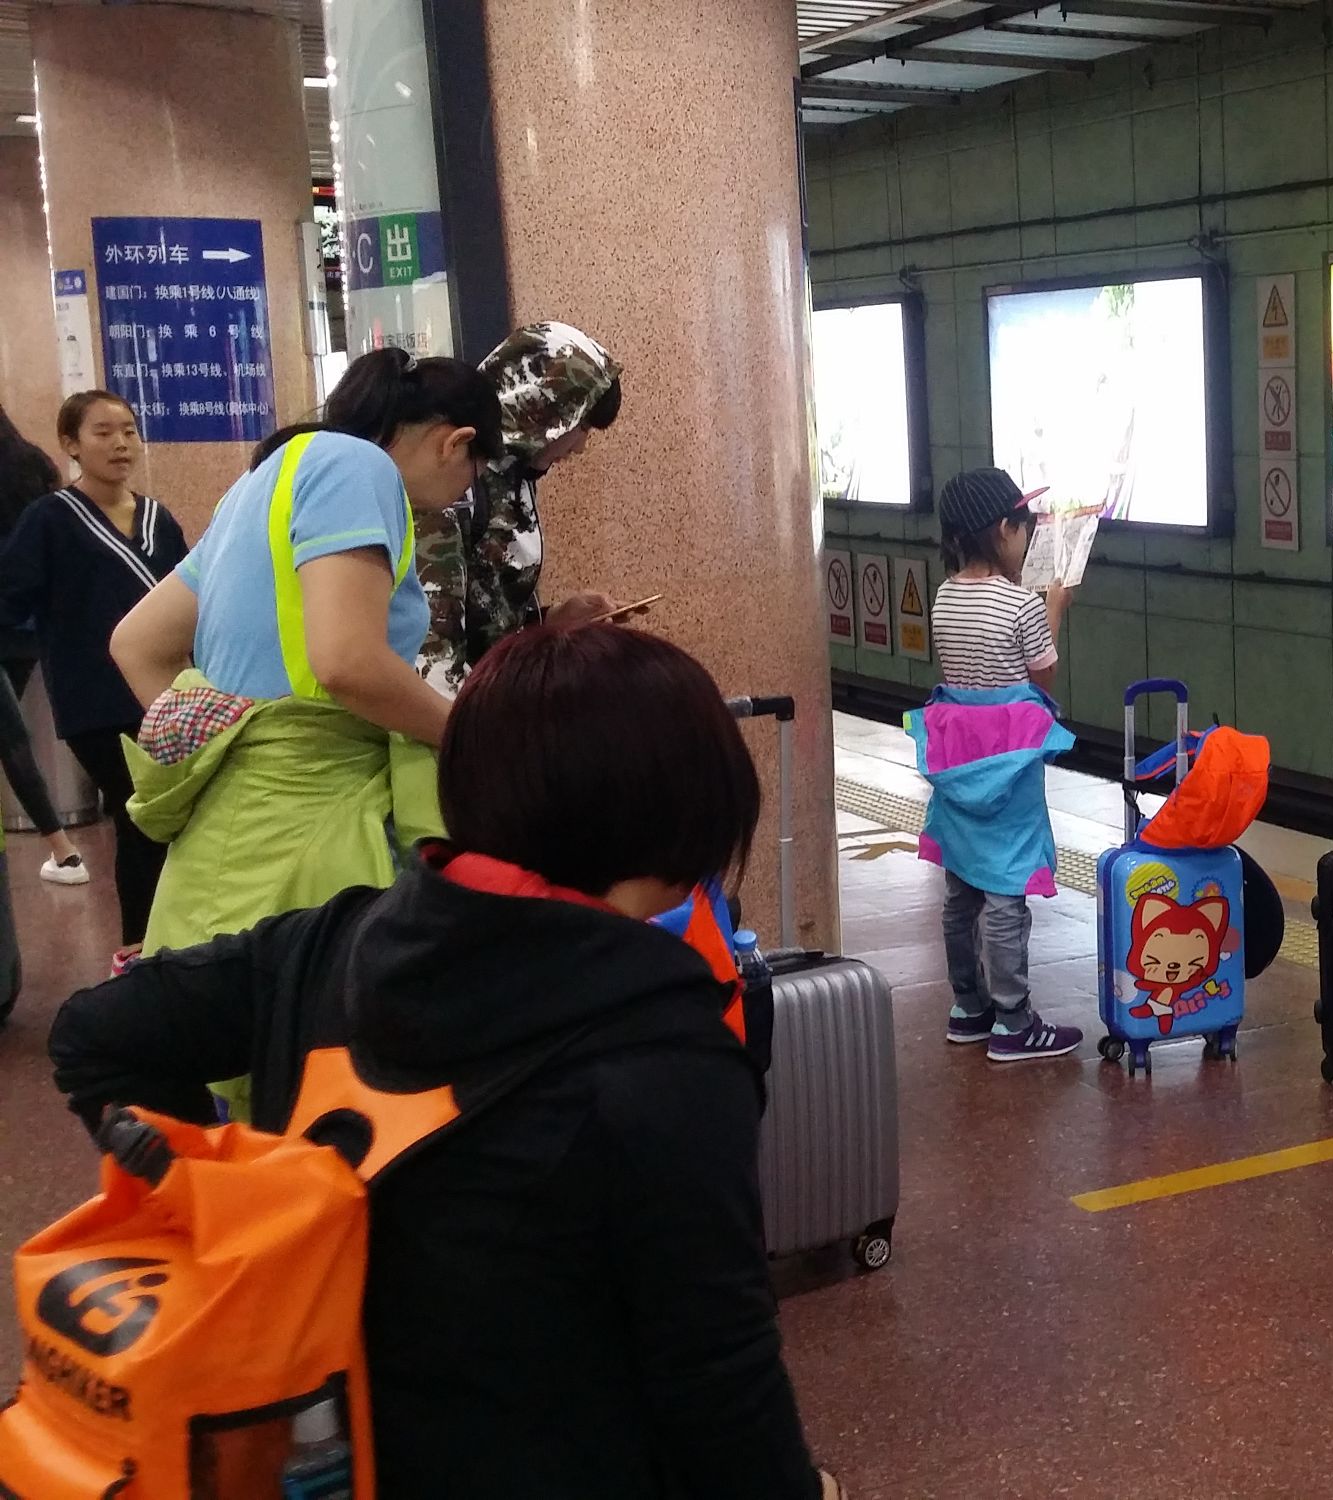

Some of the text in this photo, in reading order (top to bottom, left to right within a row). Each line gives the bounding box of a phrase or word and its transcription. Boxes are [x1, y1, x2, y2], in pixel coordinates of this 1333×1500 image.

[105, 243, 190, 265] 外环列车
[357, 232, 374, 274] C
[386, 223, 412, 262] 出
[389, 265, 413, 279] EXIT
